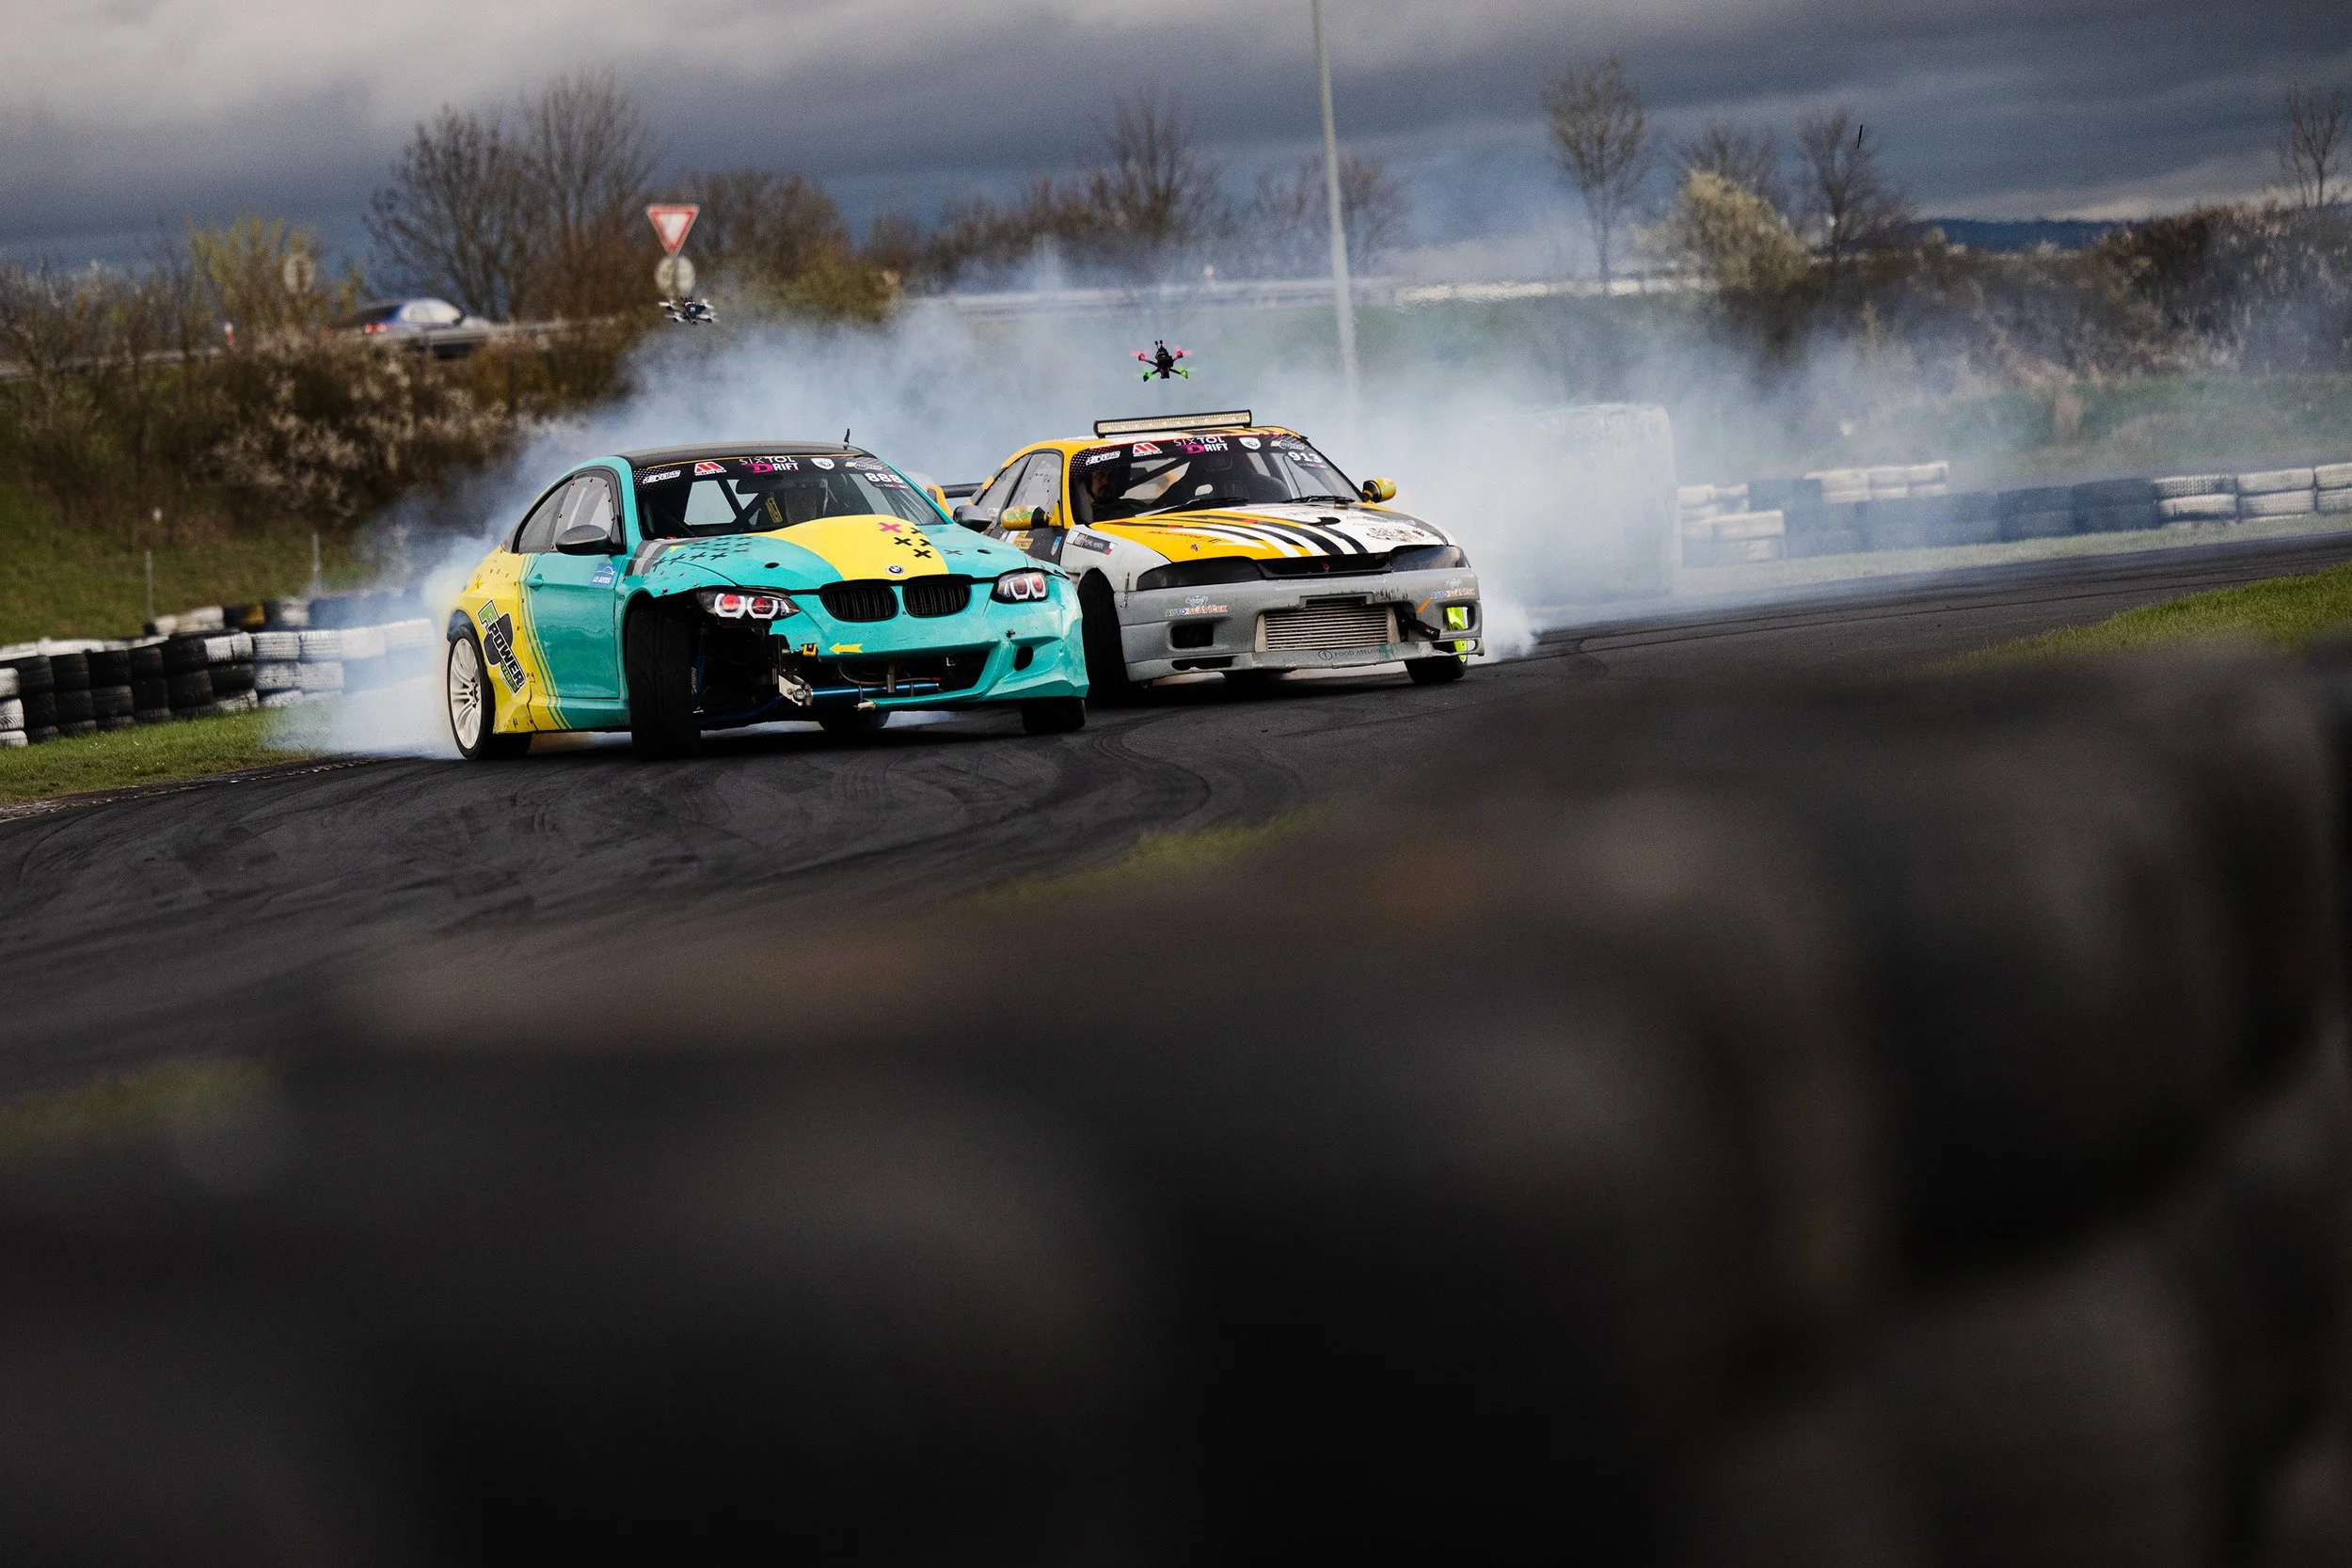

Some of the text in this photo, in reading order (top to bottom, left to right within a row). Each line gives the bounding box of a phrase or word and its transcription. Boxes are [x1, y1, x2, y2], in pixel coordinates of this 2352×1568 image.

[1173, 436, 1225, 447] SIXTOL
[1186, 443, 1229, 454] DRIFT
[739, 455, 796, 466] SIXTOL
[1287, 451, 1323, 464] 913
[752, 462, 799, 473] DRIFT
[865, 472, 904, 483] 888
